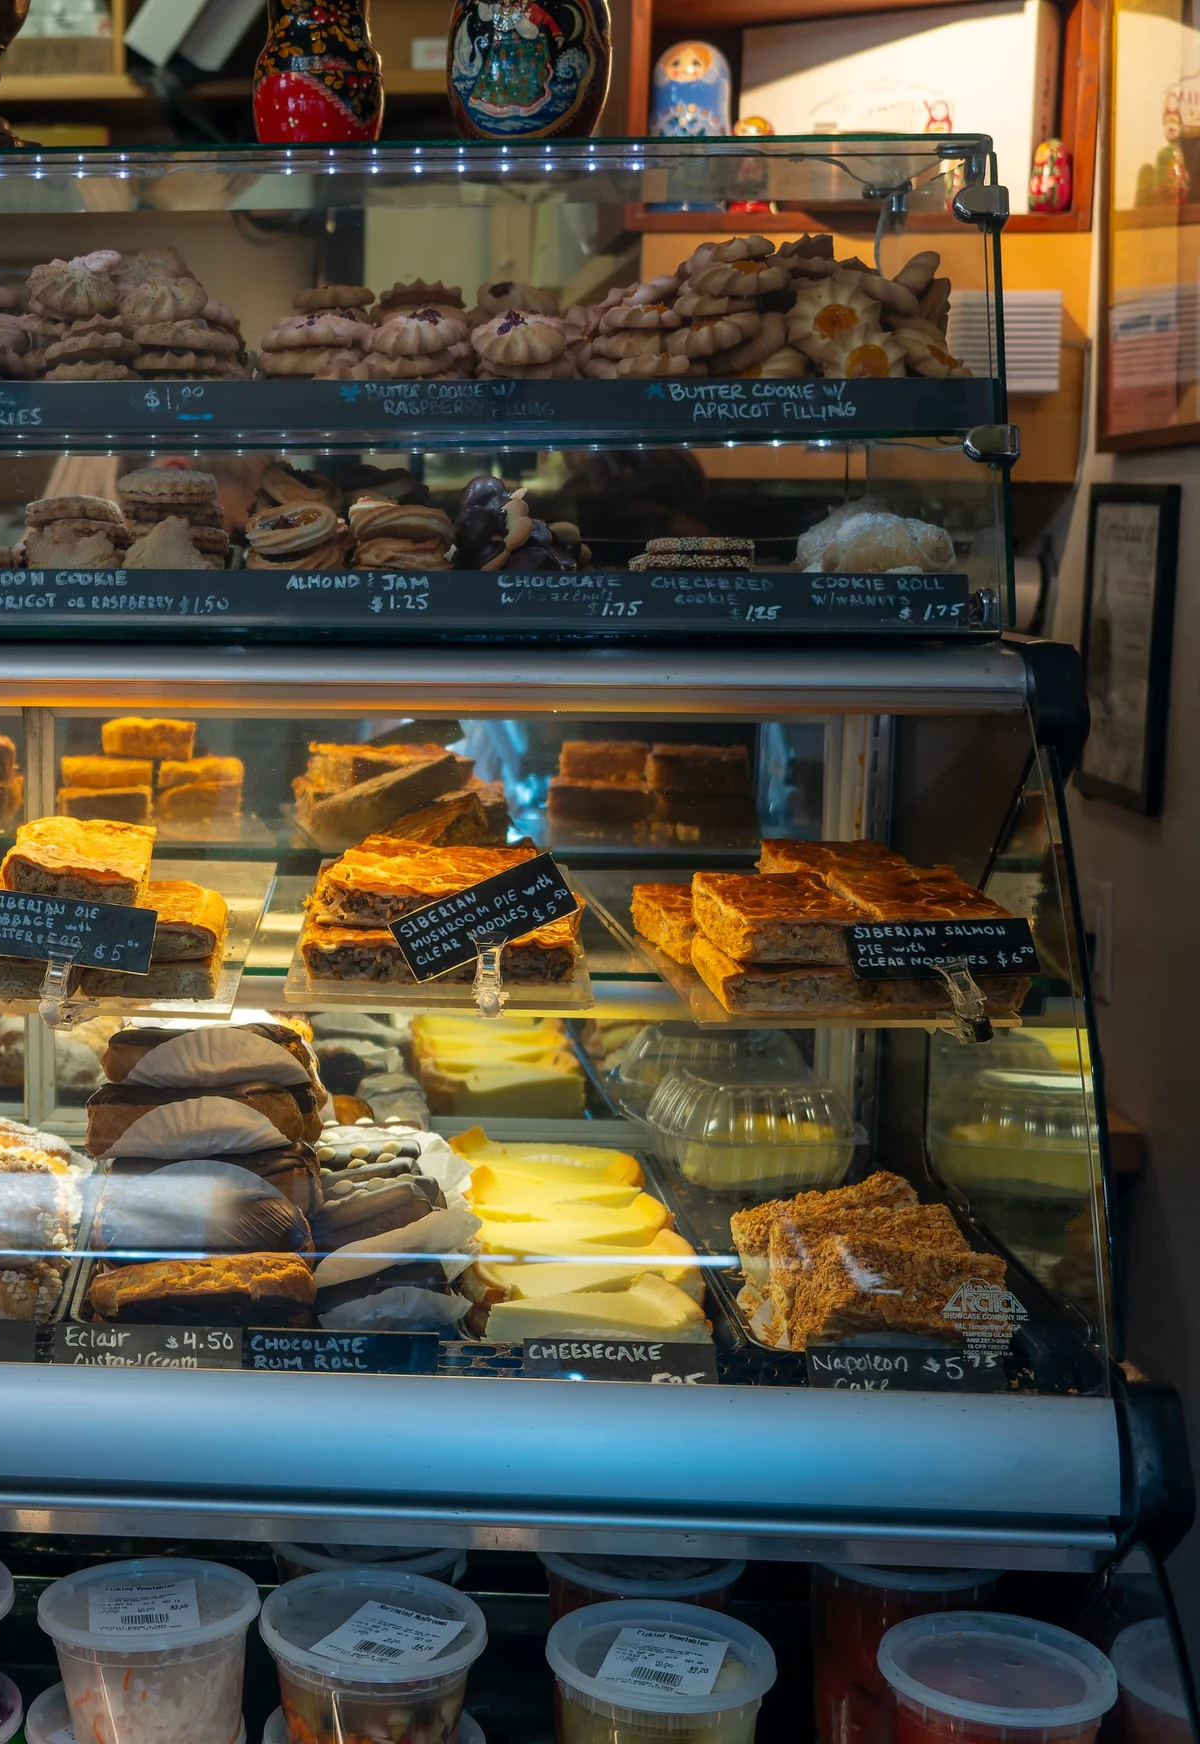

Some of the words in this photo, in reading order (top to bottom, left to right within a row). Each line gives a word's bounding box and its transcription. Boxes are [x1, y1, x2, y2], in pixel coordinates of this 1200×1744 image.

[668, 383, 746, 400] BUTTER
[752, 383, 815, 399] COOKIE
[692, 402, 775, 422] APRICOT
[783, 401, 857, 420] FILLING
[55, 570, 129, 587] COOKIE
[286, 573, 361, 591] ALMOND
[381, 573, 430, 592] JAM
[496, 573, 622, 589] CHOCOLATE
[651, 576, 774, 592] CHECKERED
[810, 576, 886, 591] COOKIE
[897, 576, 945, 592] ROLL
[91, 595, 174, 611] RASPBERRY
[74, 905, 100, 920] PIE
[400, 891, 477, 938] SIBERIAN
[409, 905, 490, 952] MUSHROOM
[493, 889, 518, 910] PIE
[415, 938, 462, 966] CLEAR
[465, 904, 529, 942] NOODLES
[853, 926, 936, 939] SIBERIAN
[944, 925, 1006, 937] SALMON
[857, 943, 884, 956] PIE
[891, 942, 926, 954] with
[857, 956, 906, 968] CLEAR
[910, 955, 989, 967] NOODLES
[942, 1312, 981, 1320] SHOWCASE
[982, 1313, 1016, 1321] COMPANY
[1016, 1314, 1030, 1322] INC.
[65, 1325, 131, 1348] Eclair
[165, 1331, 235, 1350] $4.50
[250, 1333, 369, 1355] CHOCOLATE
[528, 1342, 665, 1363] CHEESECAKE
[253, 1354, 302, 1370] RUM
[314, 1354, 369, 1370] ROLL
[811, 1351, 909, 1375] Napoleon
